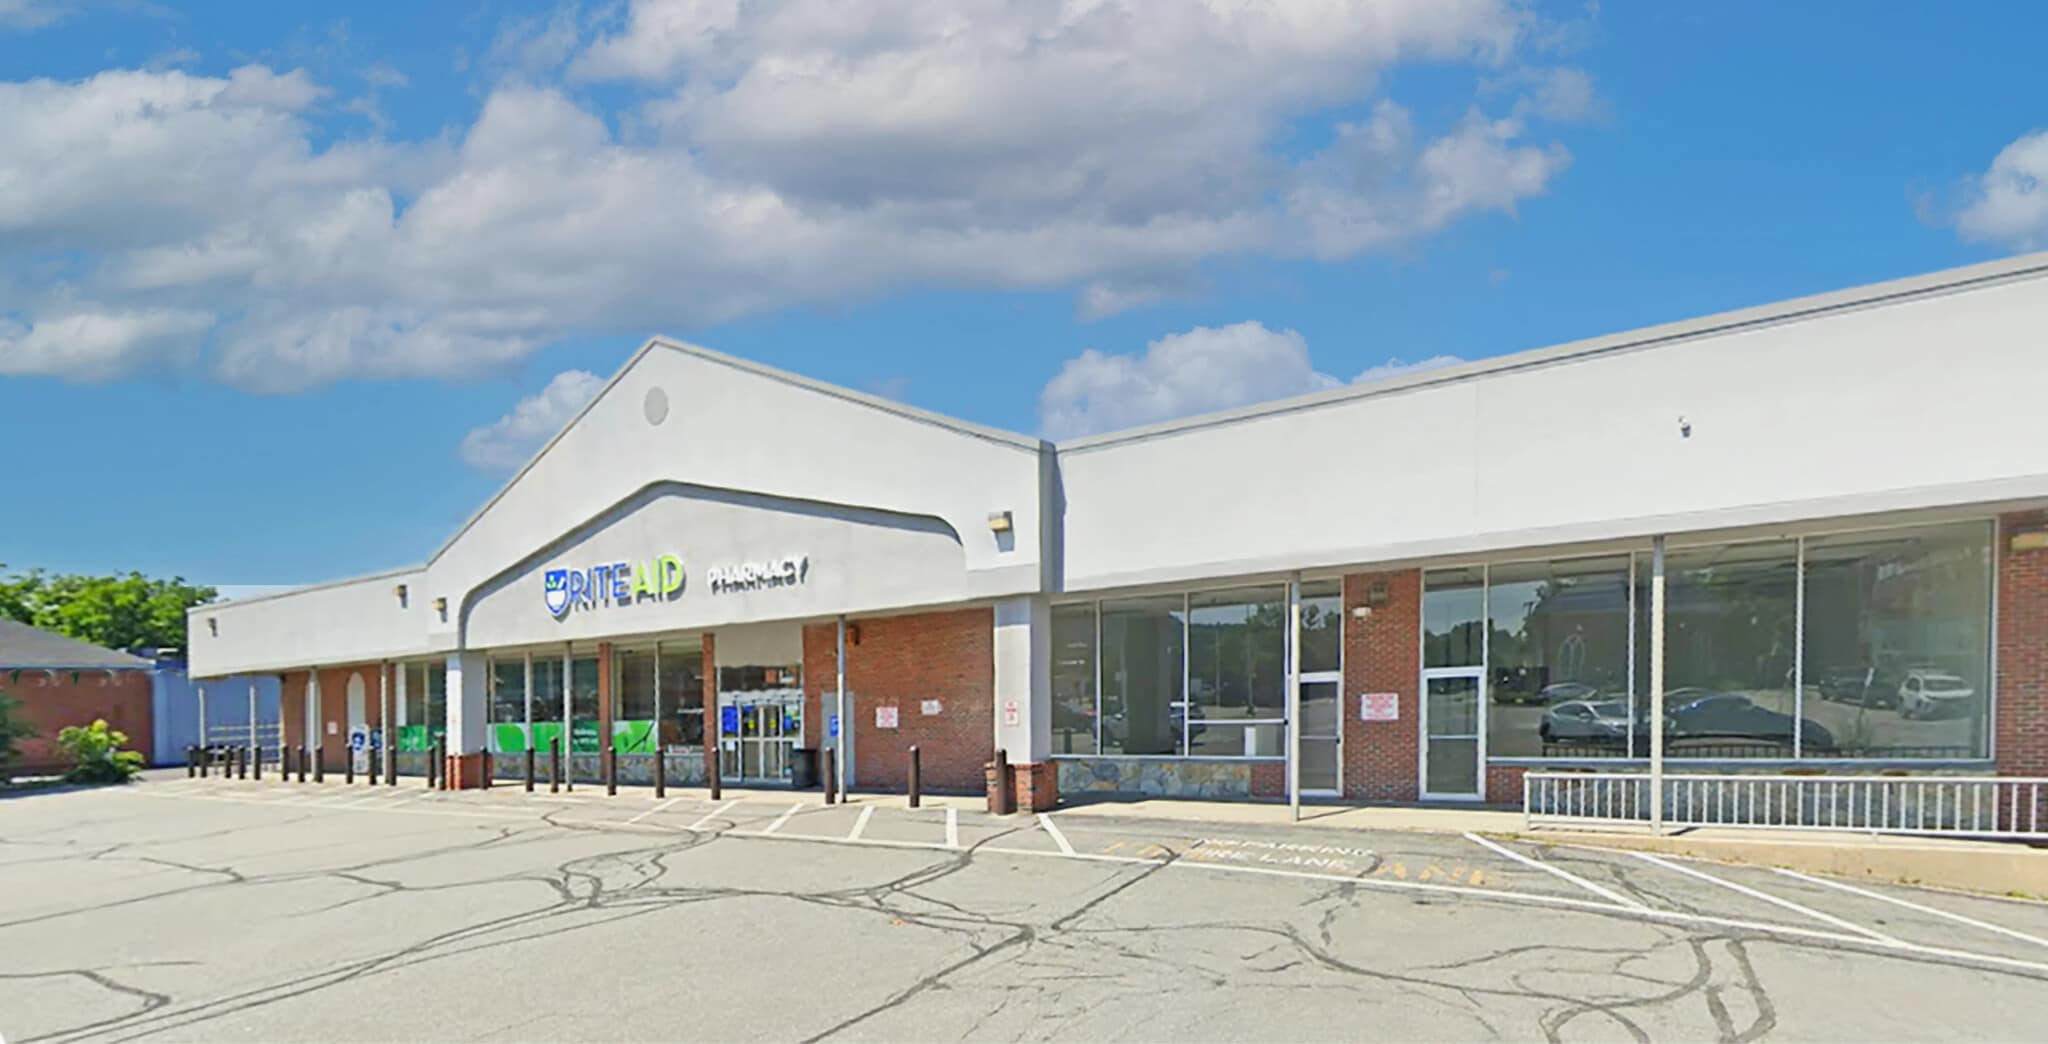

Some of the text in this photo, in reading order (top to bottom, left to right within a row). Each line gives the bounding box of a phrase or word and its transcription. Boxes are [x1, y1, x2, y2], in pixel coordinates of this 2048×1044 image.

[570, 555, 684, 603] RITE AID
[707, 554, 809, 592] PHARMACY
